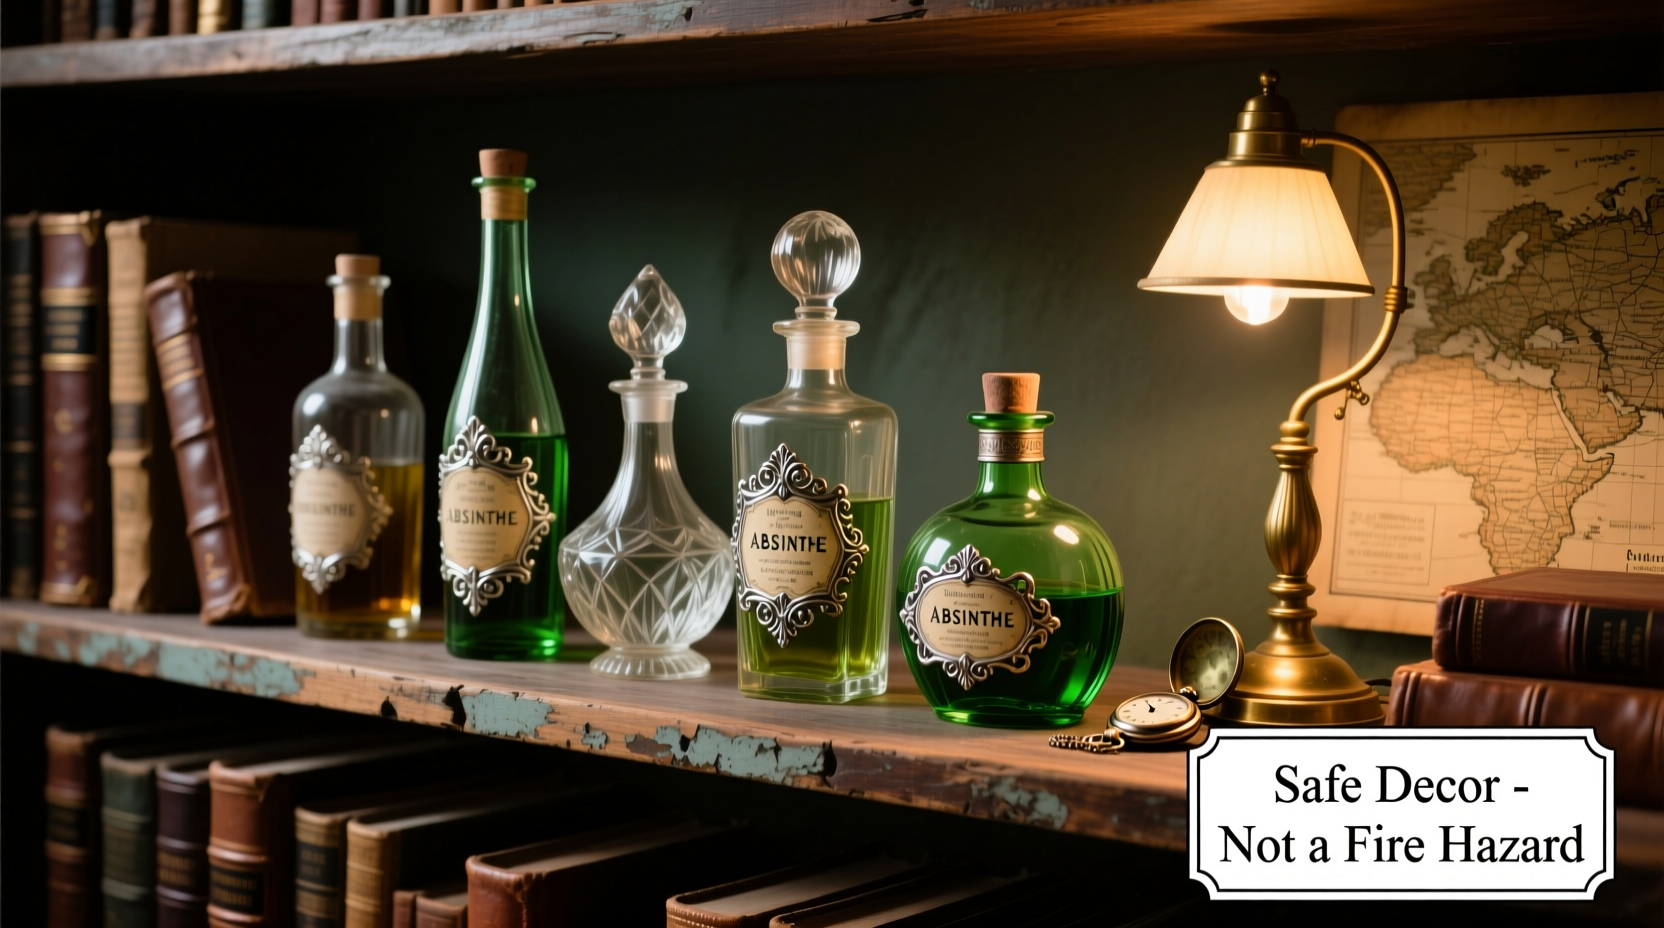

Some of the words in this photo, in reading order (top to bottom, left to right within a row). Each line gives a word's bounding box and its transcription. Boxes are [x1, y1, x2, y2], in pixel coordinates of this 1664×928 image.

[447, 507, 519, 526] ABSINTHE
[750, 532, 827, 553] ABSINTHE
[930, 606, 1015, 628] ABSINTHE
